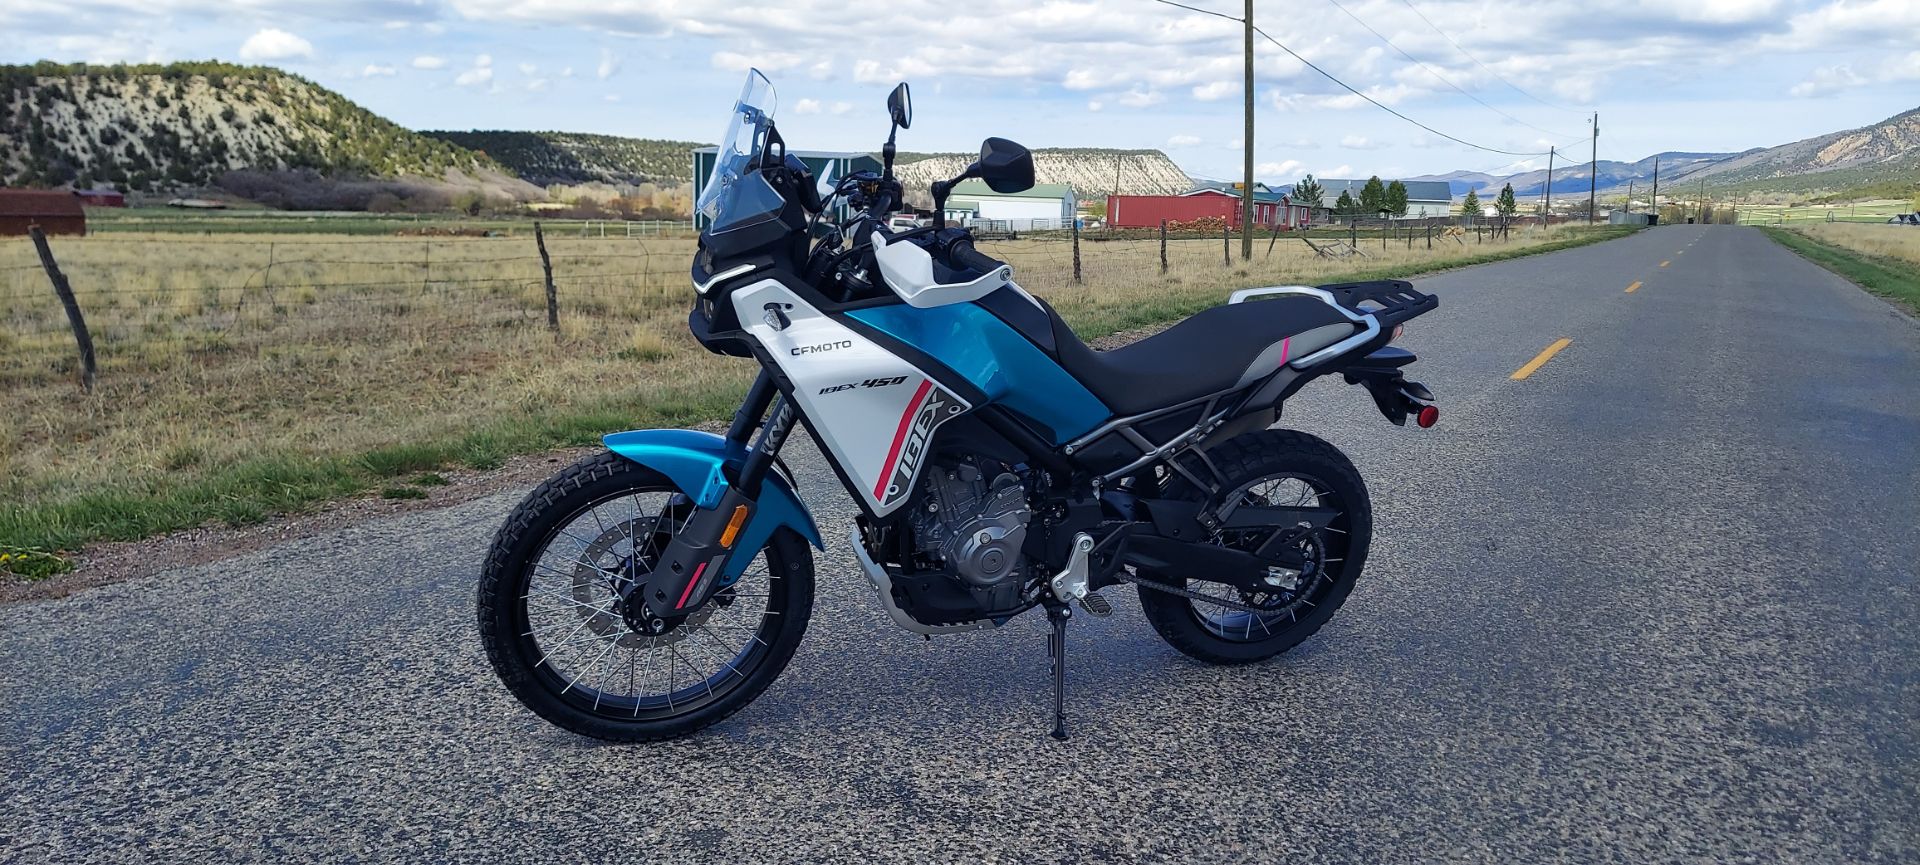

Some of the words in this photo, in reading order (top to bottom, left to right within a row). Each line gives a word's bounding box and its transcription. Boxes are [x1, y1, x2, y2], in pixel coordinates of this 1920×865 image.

[791, 340, 852, 356] CFMOTO
[819, 382, 859, 395] IBEX
[861, 376, 909, 388] 450
[900, 391, 945, 480] IBEX
